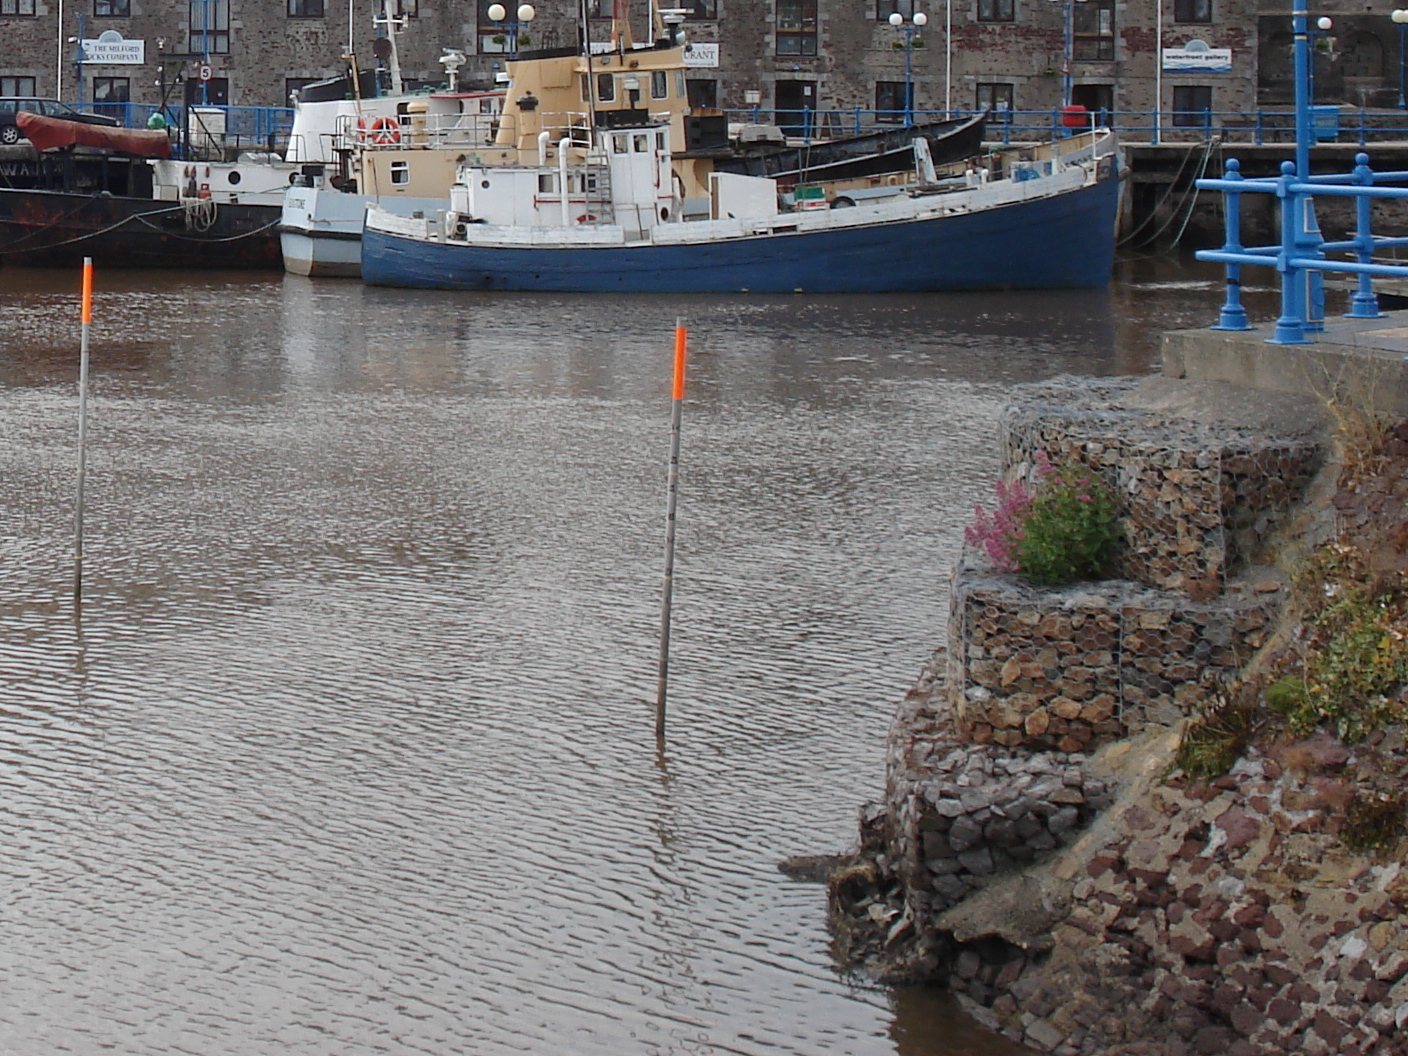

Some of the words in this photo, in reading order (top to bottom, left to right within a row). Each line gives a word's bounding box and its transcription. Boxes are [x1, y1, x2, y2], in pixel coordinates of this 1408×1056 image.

[94, 45, 107, 53] THE
[108, 45, 140, 53] MILFORD
[86, 53, 105, 61] OCKS
[106, 53, 138, 61] COMPANY
[202, 69, 209, 78] 5
